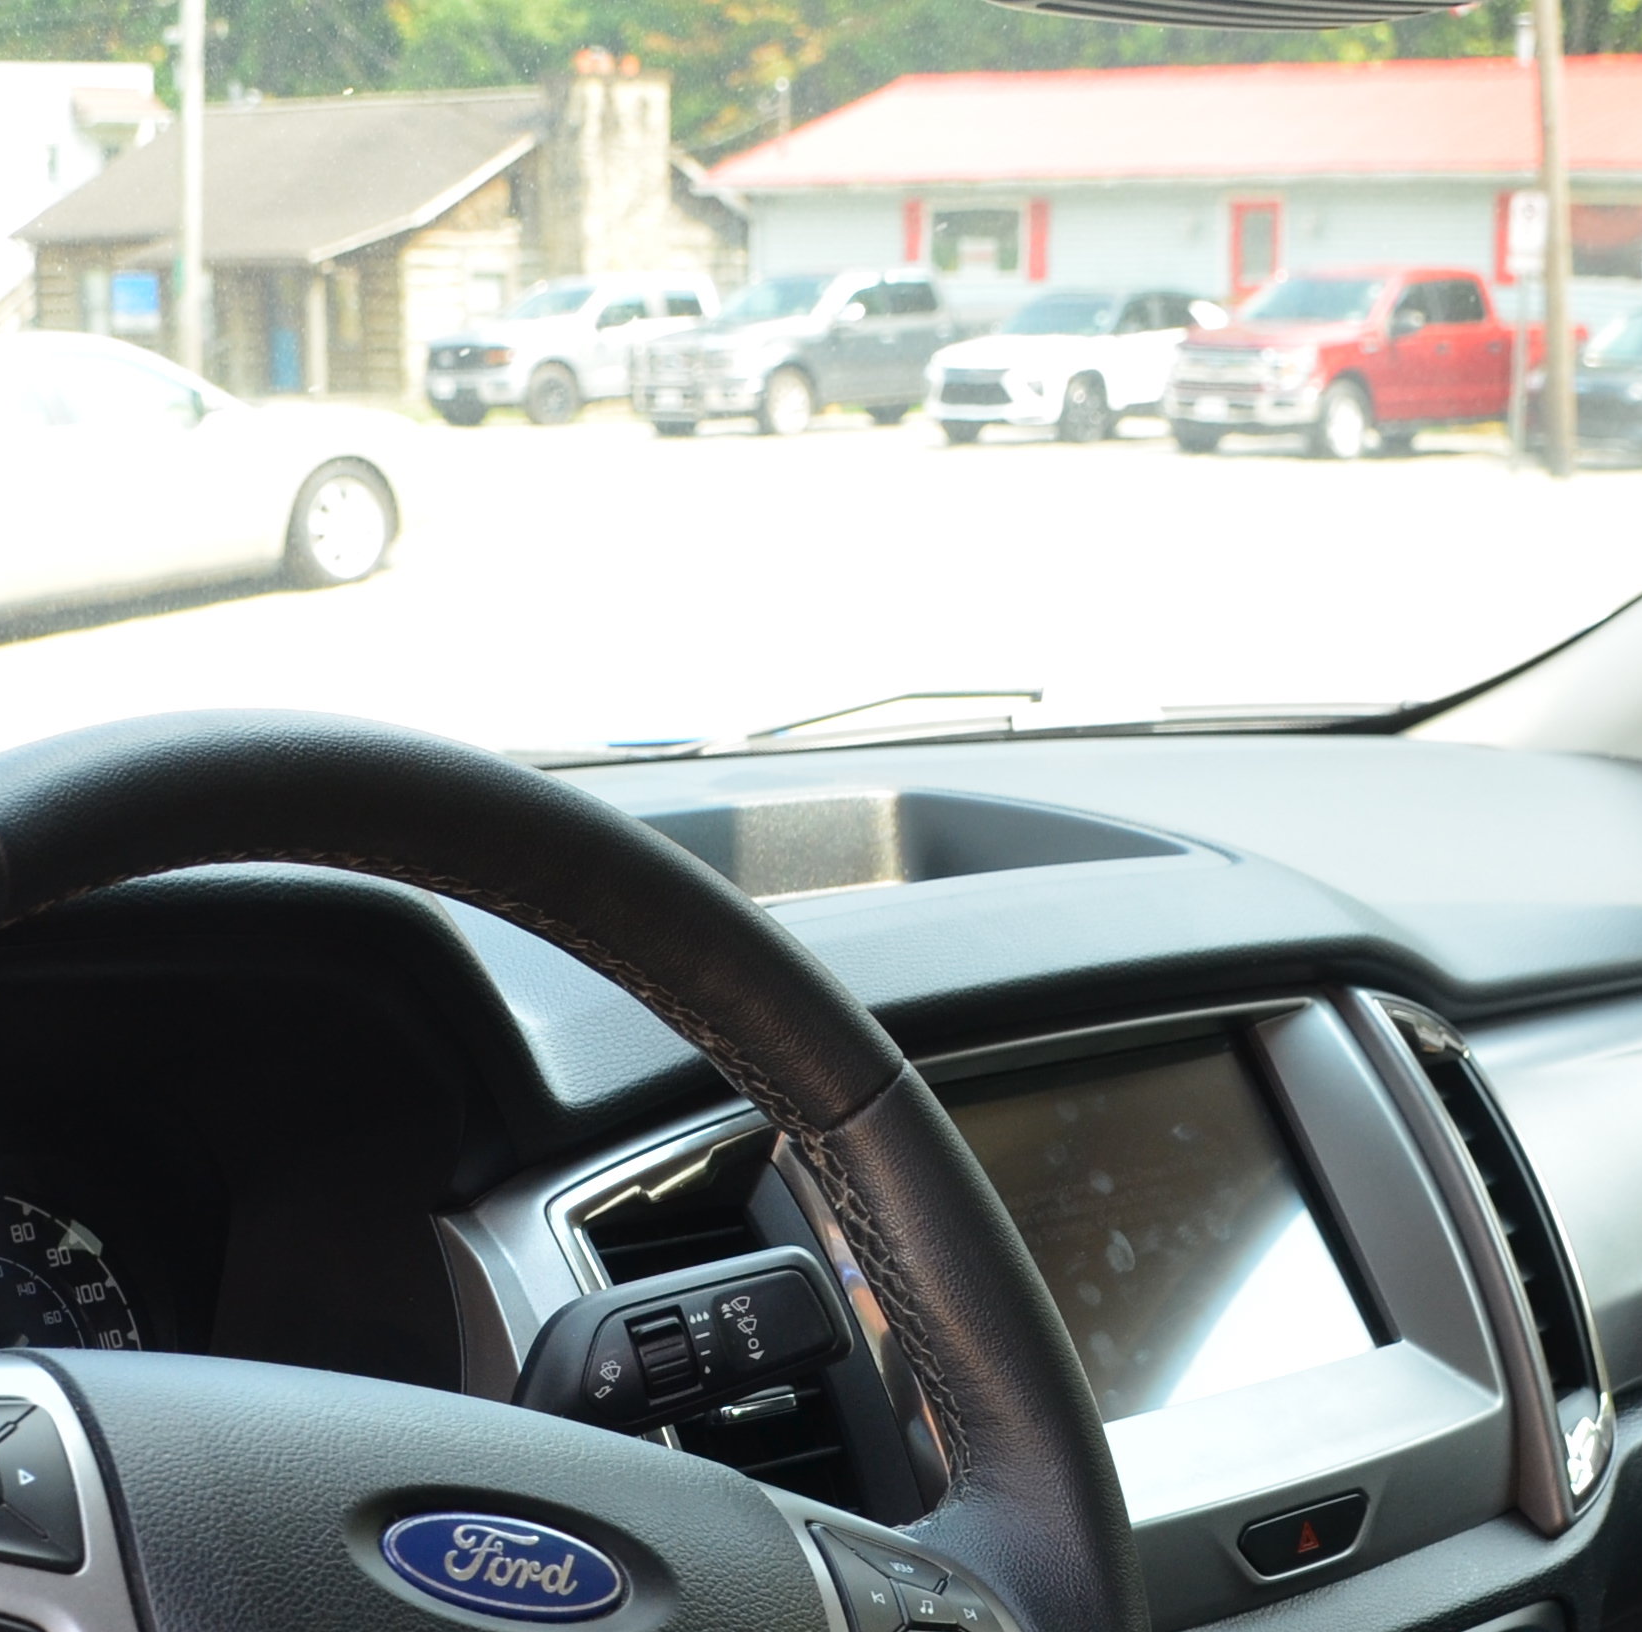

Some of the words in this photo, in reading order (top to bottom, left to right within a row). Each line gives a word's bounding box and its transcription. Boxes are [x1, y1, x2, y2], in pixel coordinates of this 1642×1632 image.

[10, 1222, 35, 1243] 80
[46, 1246, 72, 1268] 90
[16, 1282, 37, 1297] 140
[74, 1282, 105, 1305] 100
[42, 1310, 63, 1325] 160
[444, 1524, 578, 1596] Ford
